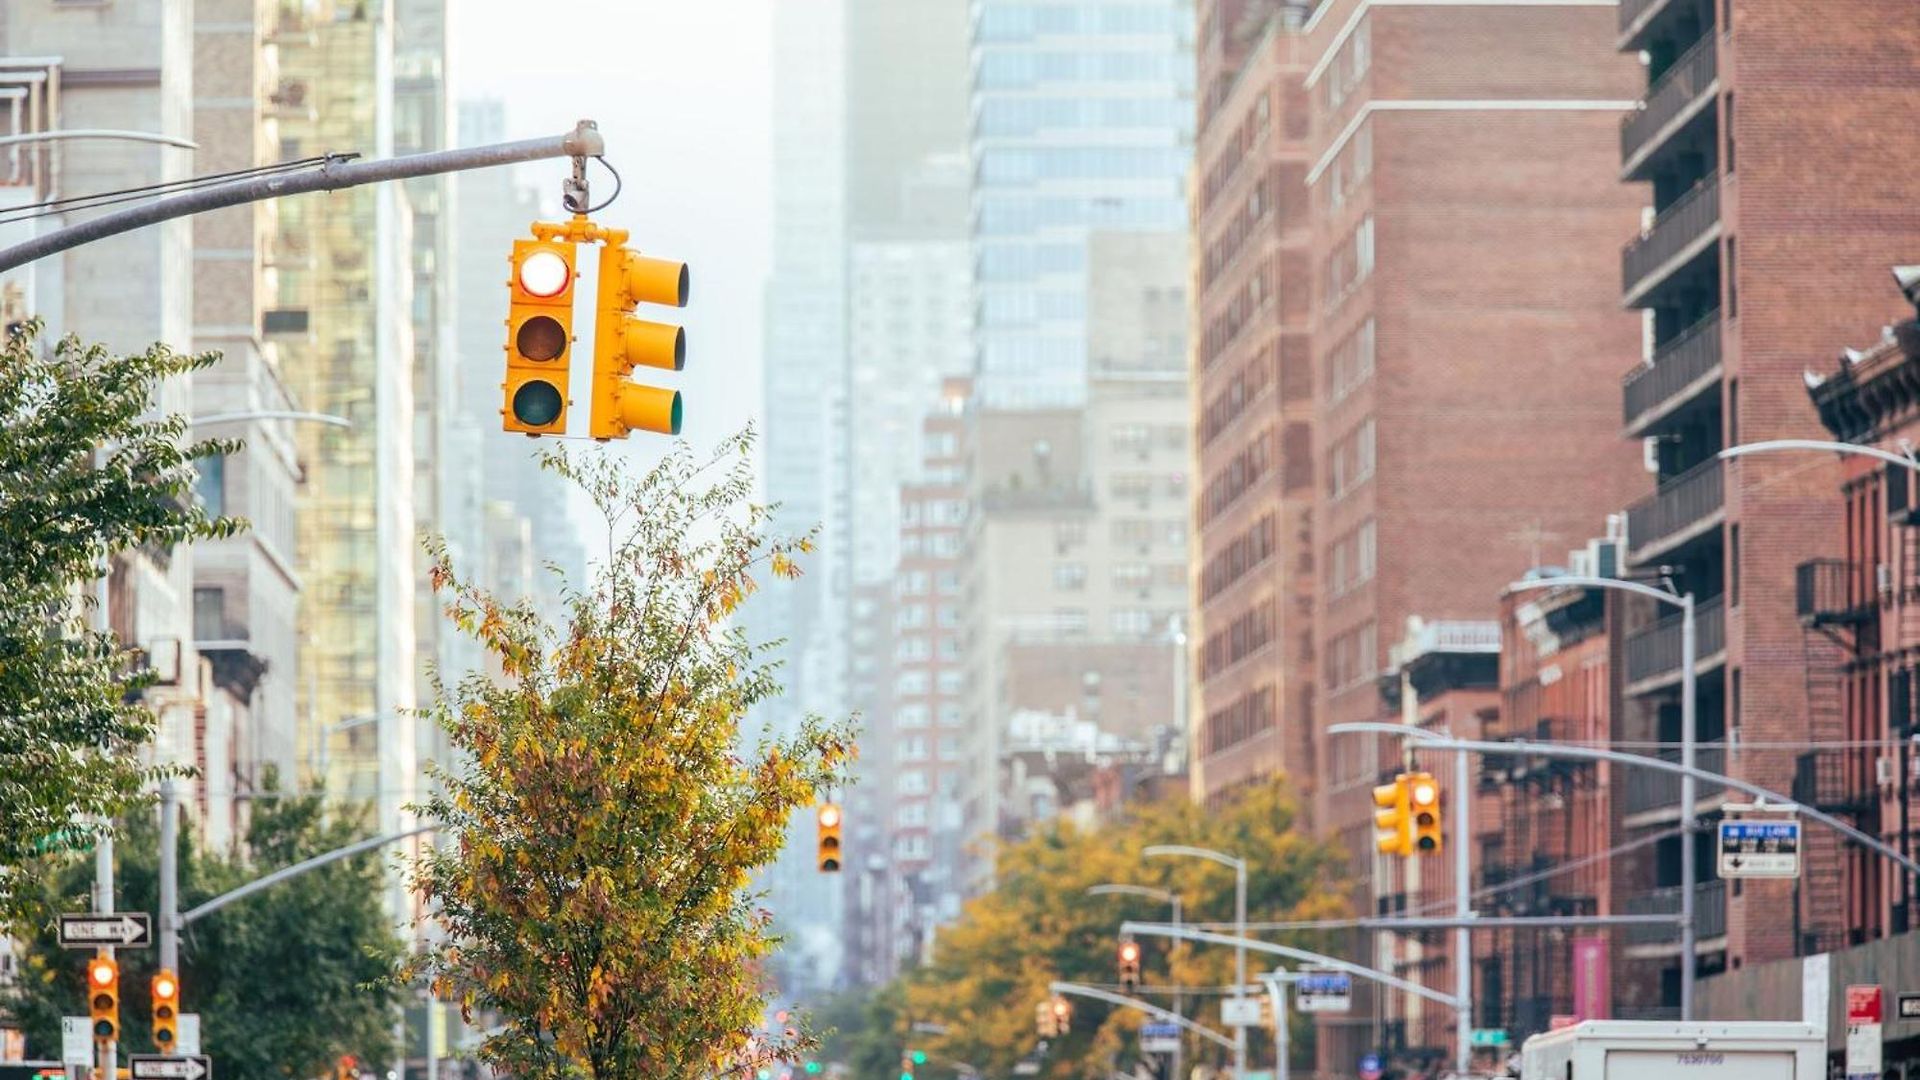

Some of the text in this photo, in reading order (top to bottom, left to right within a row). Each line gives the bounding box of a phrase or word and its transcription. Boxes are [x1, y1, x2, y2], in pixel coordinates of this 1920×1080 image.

[71, 925, 134, 936] ONE WAY
[142, 1065, 197, 1075] ONE WAY
